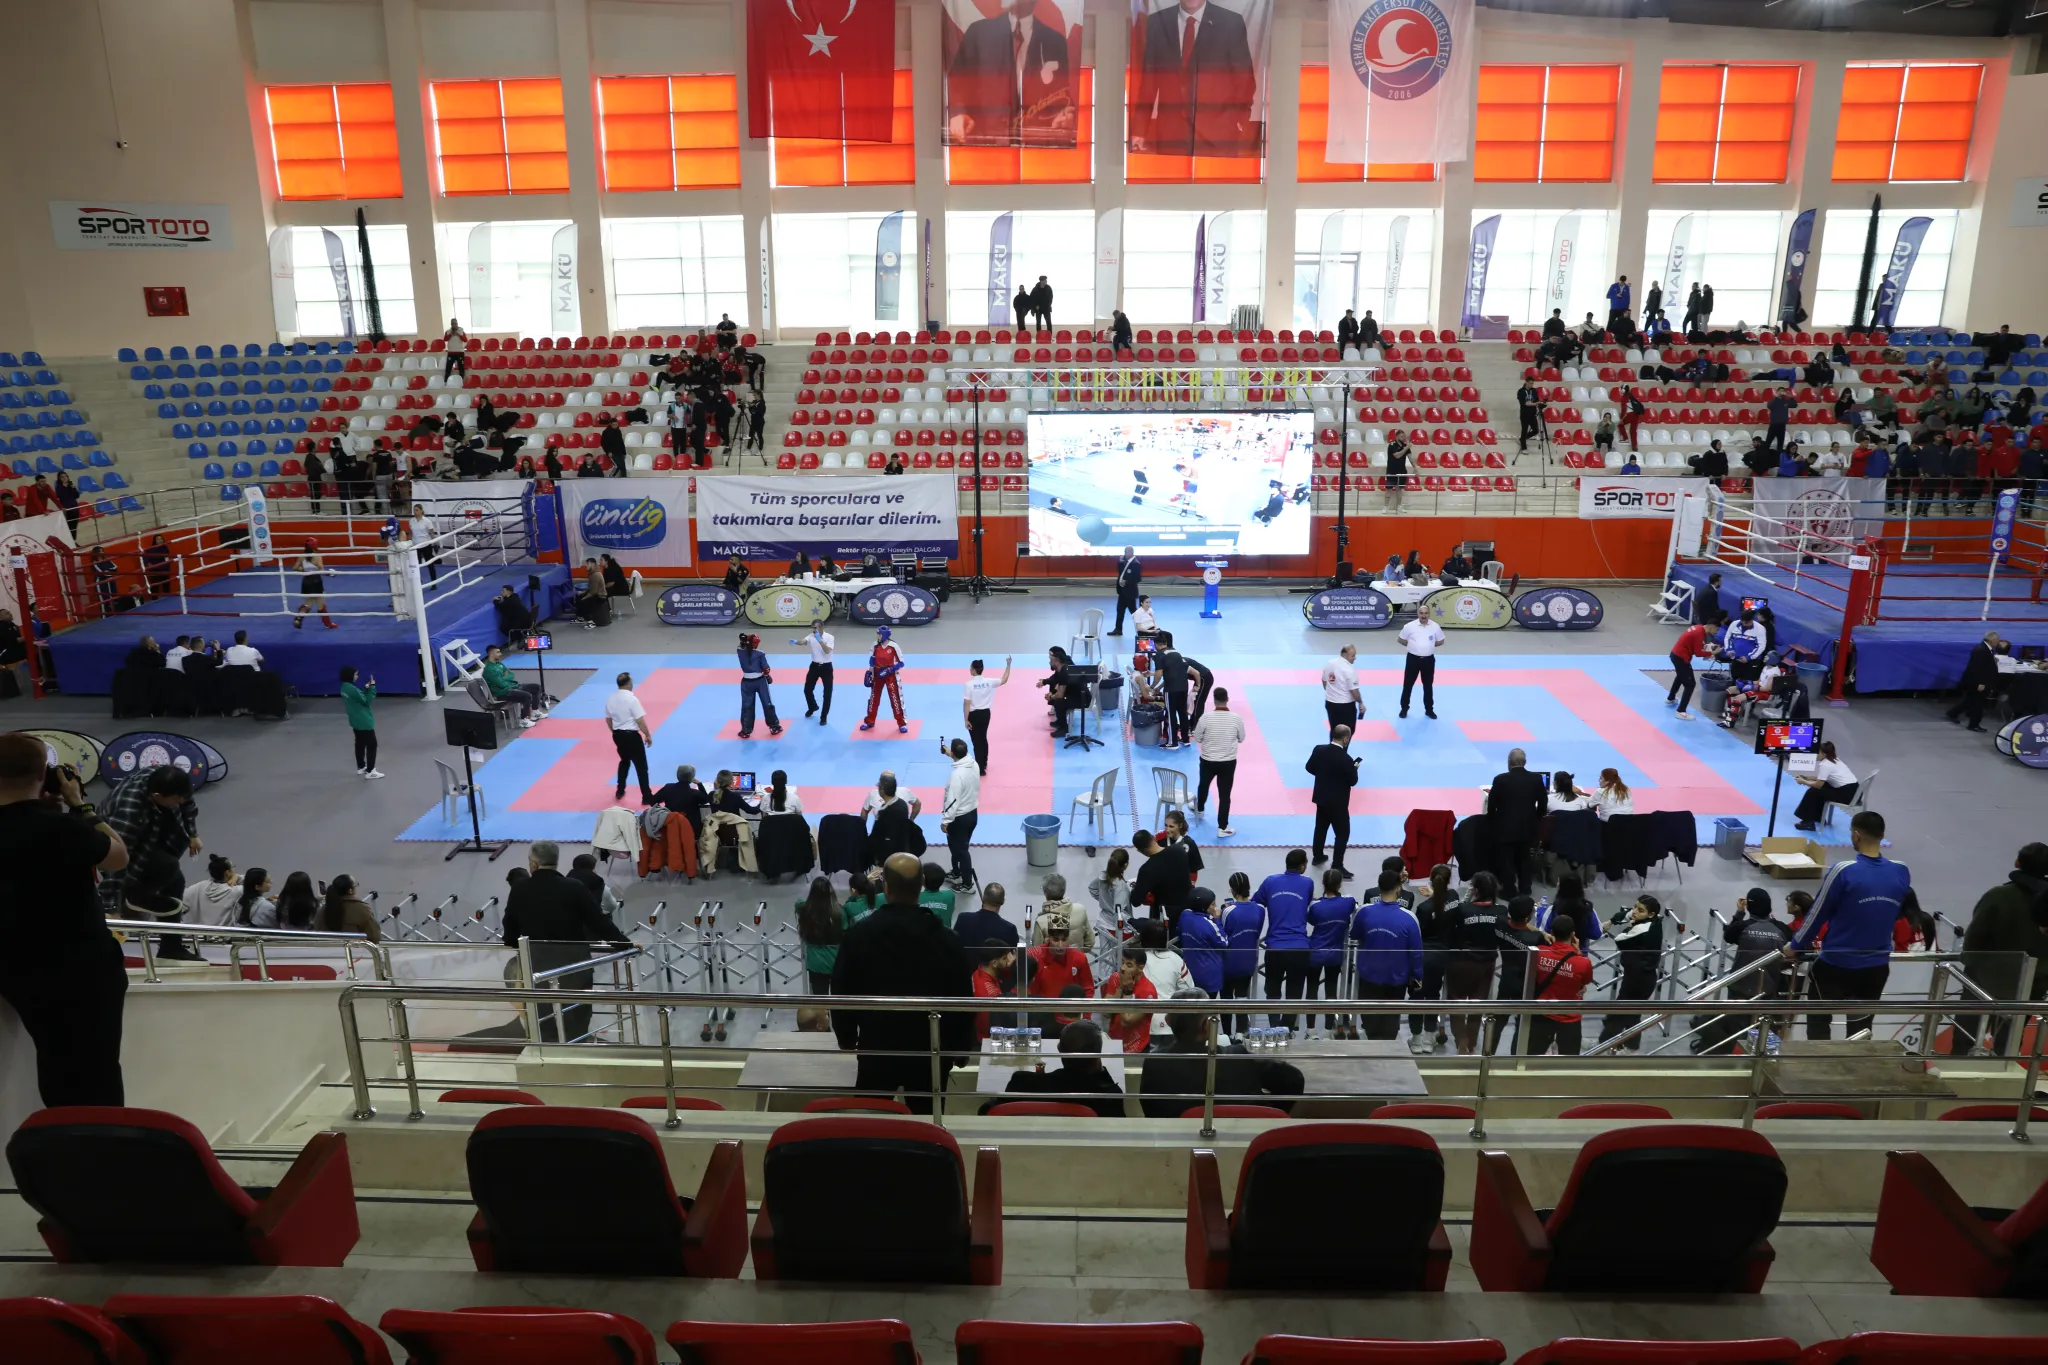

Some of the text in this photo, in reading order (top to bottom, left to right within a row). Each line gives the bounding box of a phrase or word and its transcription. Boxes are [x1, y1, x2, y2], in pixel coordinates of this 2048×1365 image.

[1352, 29, 1369, 75] MEHMET
[1361, 5, 1381, 29] AKİF
[1387, 89, 1412, 99] 2006
[557, 253, 572, 312] MAKÜ
[991, 243, 1008, 307] MAKÜ
[1211, 243, 1227, 305] MAKÜ
[1469, 243, 1488, 307] MAKÜ
[1664, 244, 1685, 307] MAKÜ
[1882, 240, 1912, 306] MAKÜ
[712, 511, 941, 529] takımlara başarılar dilerim.
[750, 492, 904, 511] Tüm sporculara ve
[713, 546, 749, 556] MAKÜ
[1760, 728, 1765, 736] 3
